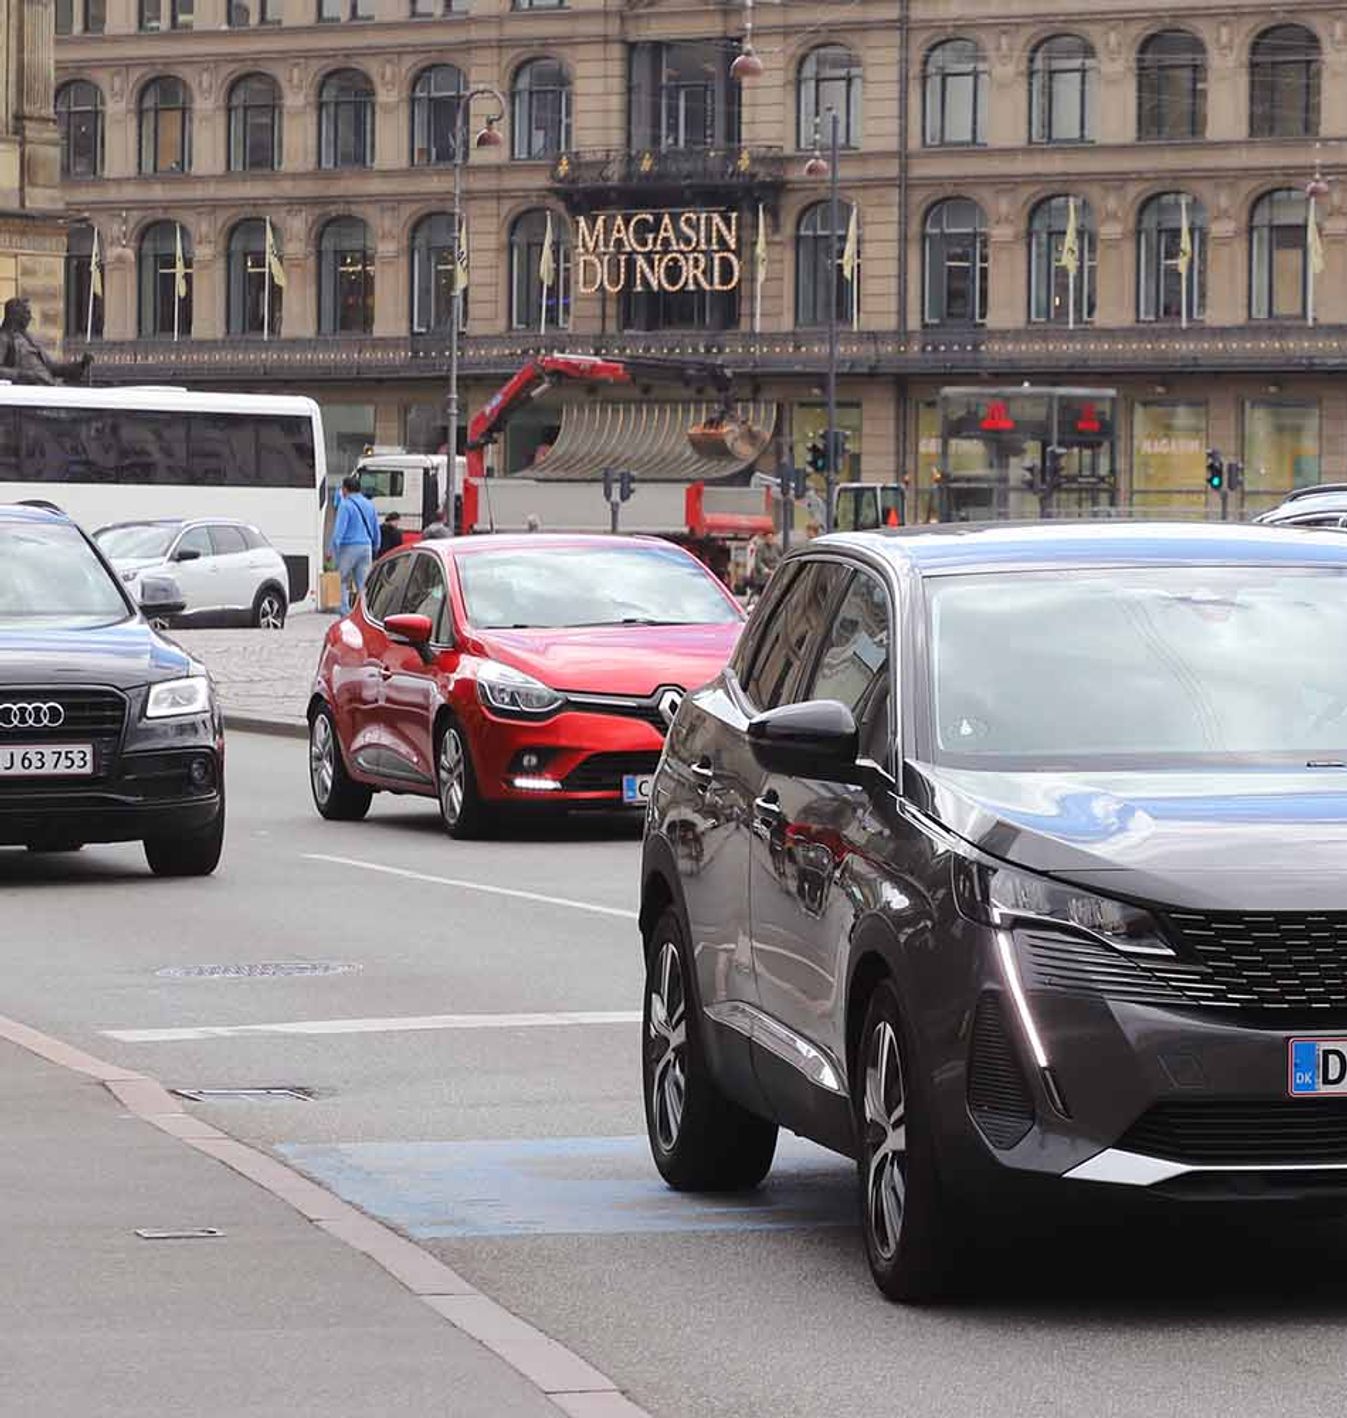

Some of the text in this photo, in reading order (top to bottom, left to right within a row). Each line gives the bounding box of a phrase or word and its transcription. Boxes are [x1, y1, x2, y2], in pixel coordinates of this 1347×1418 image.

[576, 213, 738, 252] MAGASIN
[579, 252, 740, 293] DU NORD
[21, 751, 46, 770] 63
[52, 750, 88, 770] 753
[1296, 1071, 1312, 1085] DK
